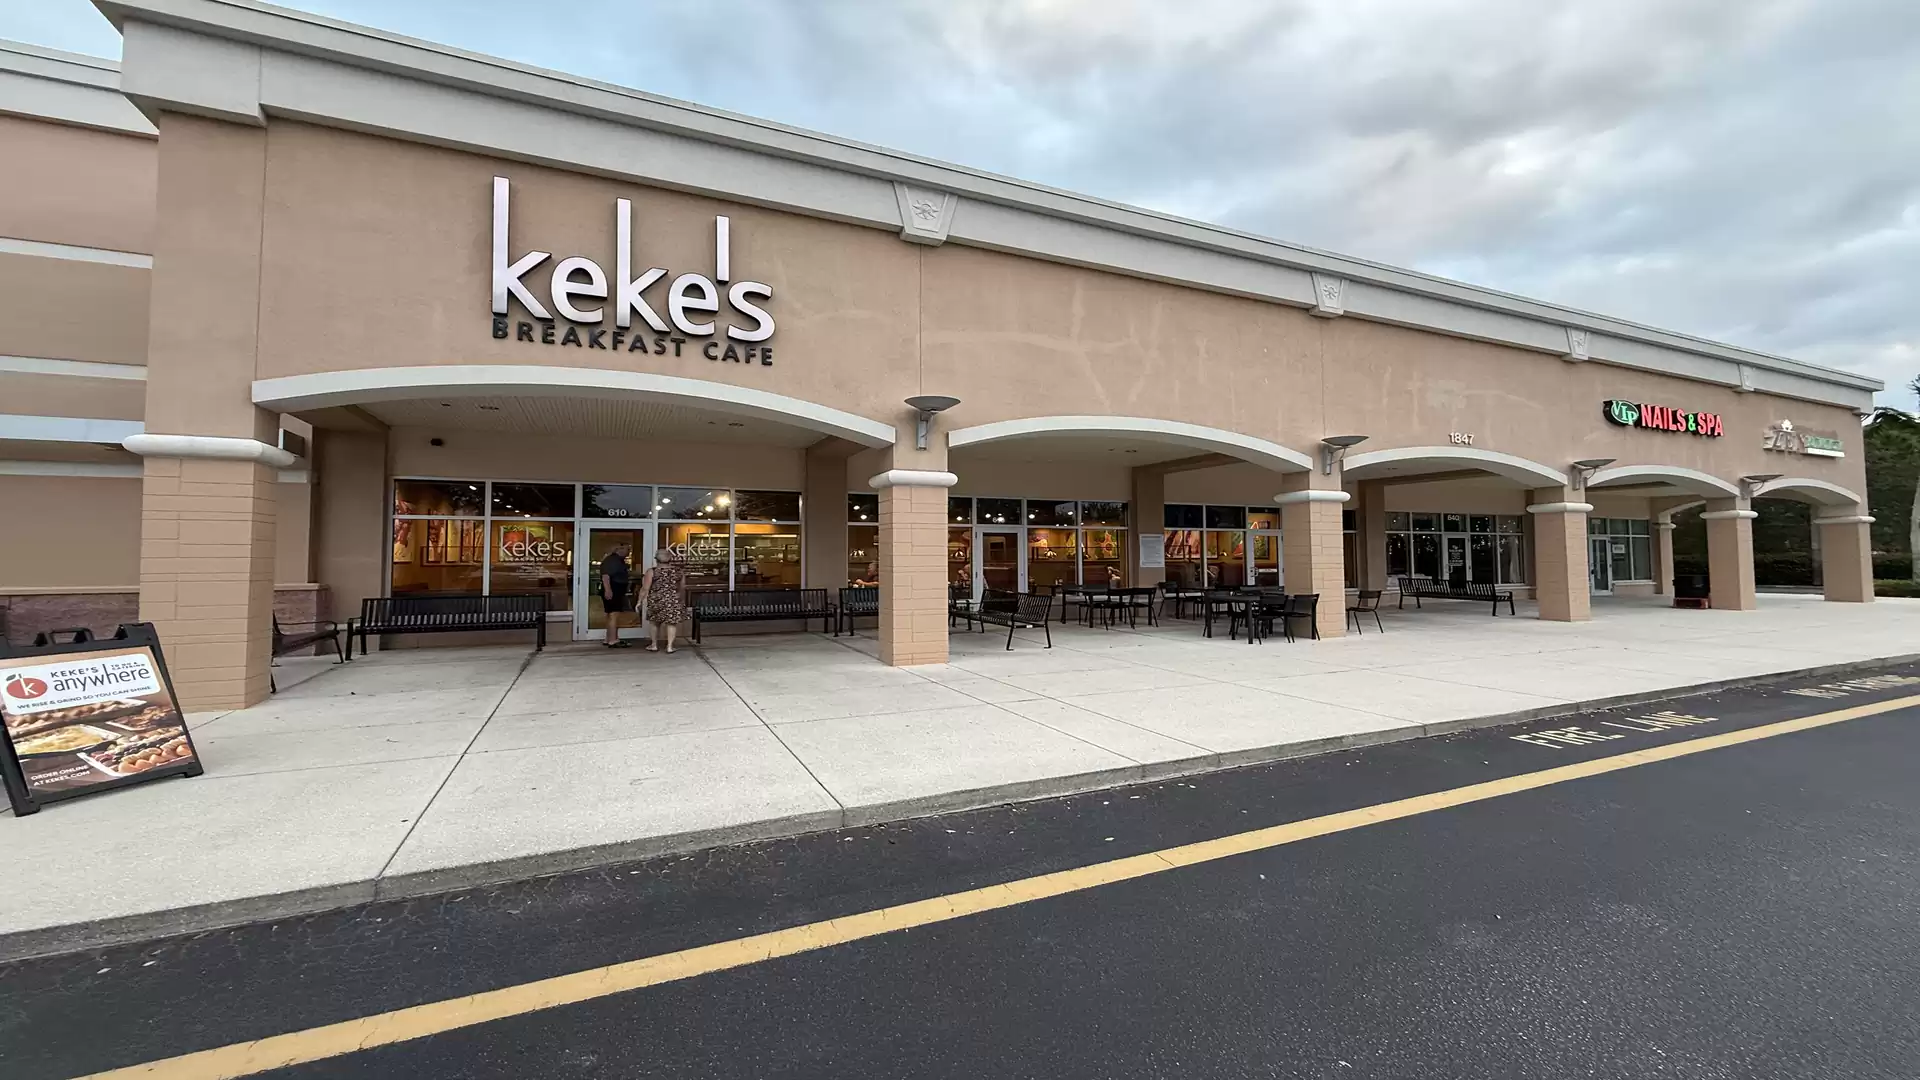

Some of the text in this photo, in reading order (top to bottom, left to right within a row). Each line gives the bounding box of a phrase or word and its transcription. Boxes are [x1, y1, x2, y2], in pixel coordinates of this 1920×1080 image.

[492, 175, 776, 342] keke's
[492, 316, 774, 366] BREAKFAST CAFE
[1612, 400, 1724, 437] VIP NAILS & SPA
[1449, 431, 1475, 445] 1847
[607, 508, 627, 517] 610
[50, 666, 99, 679] KEKE'S
[53, 663, 151, 692] anywhere
[56, 696, 82, 704] GRIND
[95, 691, 112, 699] YOU
[130, 685, 152, 693] SHINE
[1509, 711, 1719, 749] FIRE LANE
[31, 764, 89, 781] ORDER ONLINE
